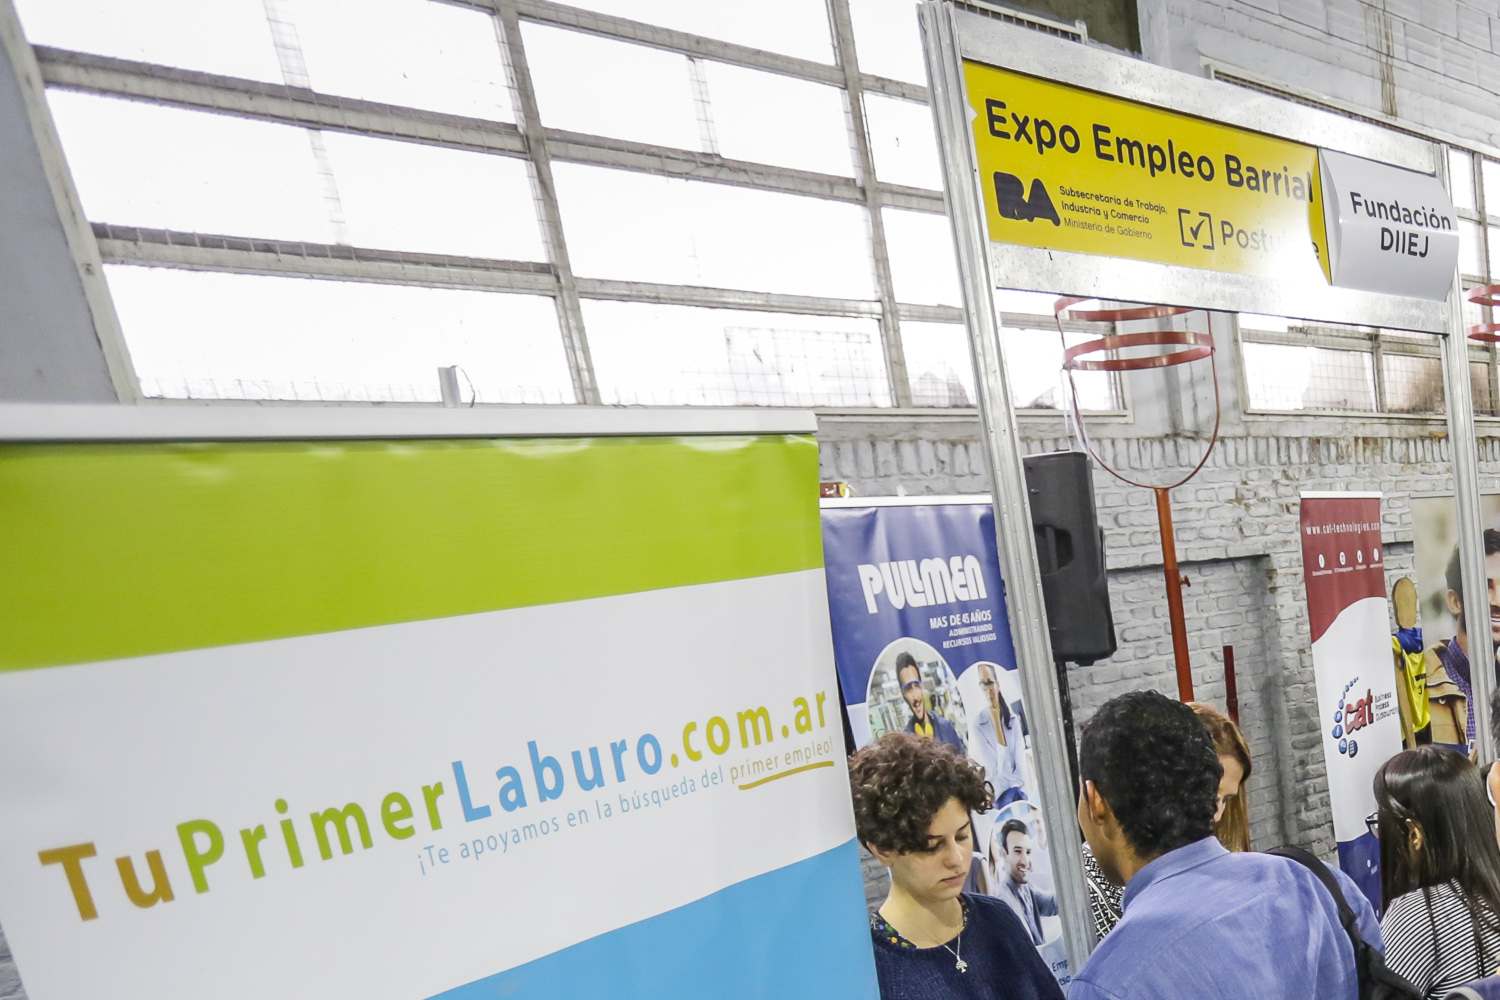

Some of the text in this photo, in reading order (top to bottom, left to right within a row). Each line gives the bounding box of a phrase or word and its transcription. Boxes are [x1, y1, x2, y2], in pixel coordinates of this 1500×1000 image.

[984, 97, 1314, 203] Expo Empleo Barrial
[1061, 201, 1150, 224] Industria y Comercio
[1124, 197, 1134, 208] de
[1136, 199, 1168, 215] Trabajo,
[1349, 191, 1452, 231] Fundación
[1064, 218, 1153, 240] Ministerio de Gobierno
[1380, 226, 1430, 259] DIIEJ
[929, 615, 948, 630] MAS
[949, 613, 961, 626] DE
[970, 608, 992, 623] AÑOS
[38, 689, 828, 923] TuPrimerLaburo.com.ar
[459, 818, 560, 862] apoyamos
[566, 808, 590, 828] en
[594, 799, 613, 820] la
[618, 779, 697, 815] búsqueda
[700, 765, 725, 789] del
[729, 755, 780, 785] primer
[783, 735, 834, 766] empleo!
